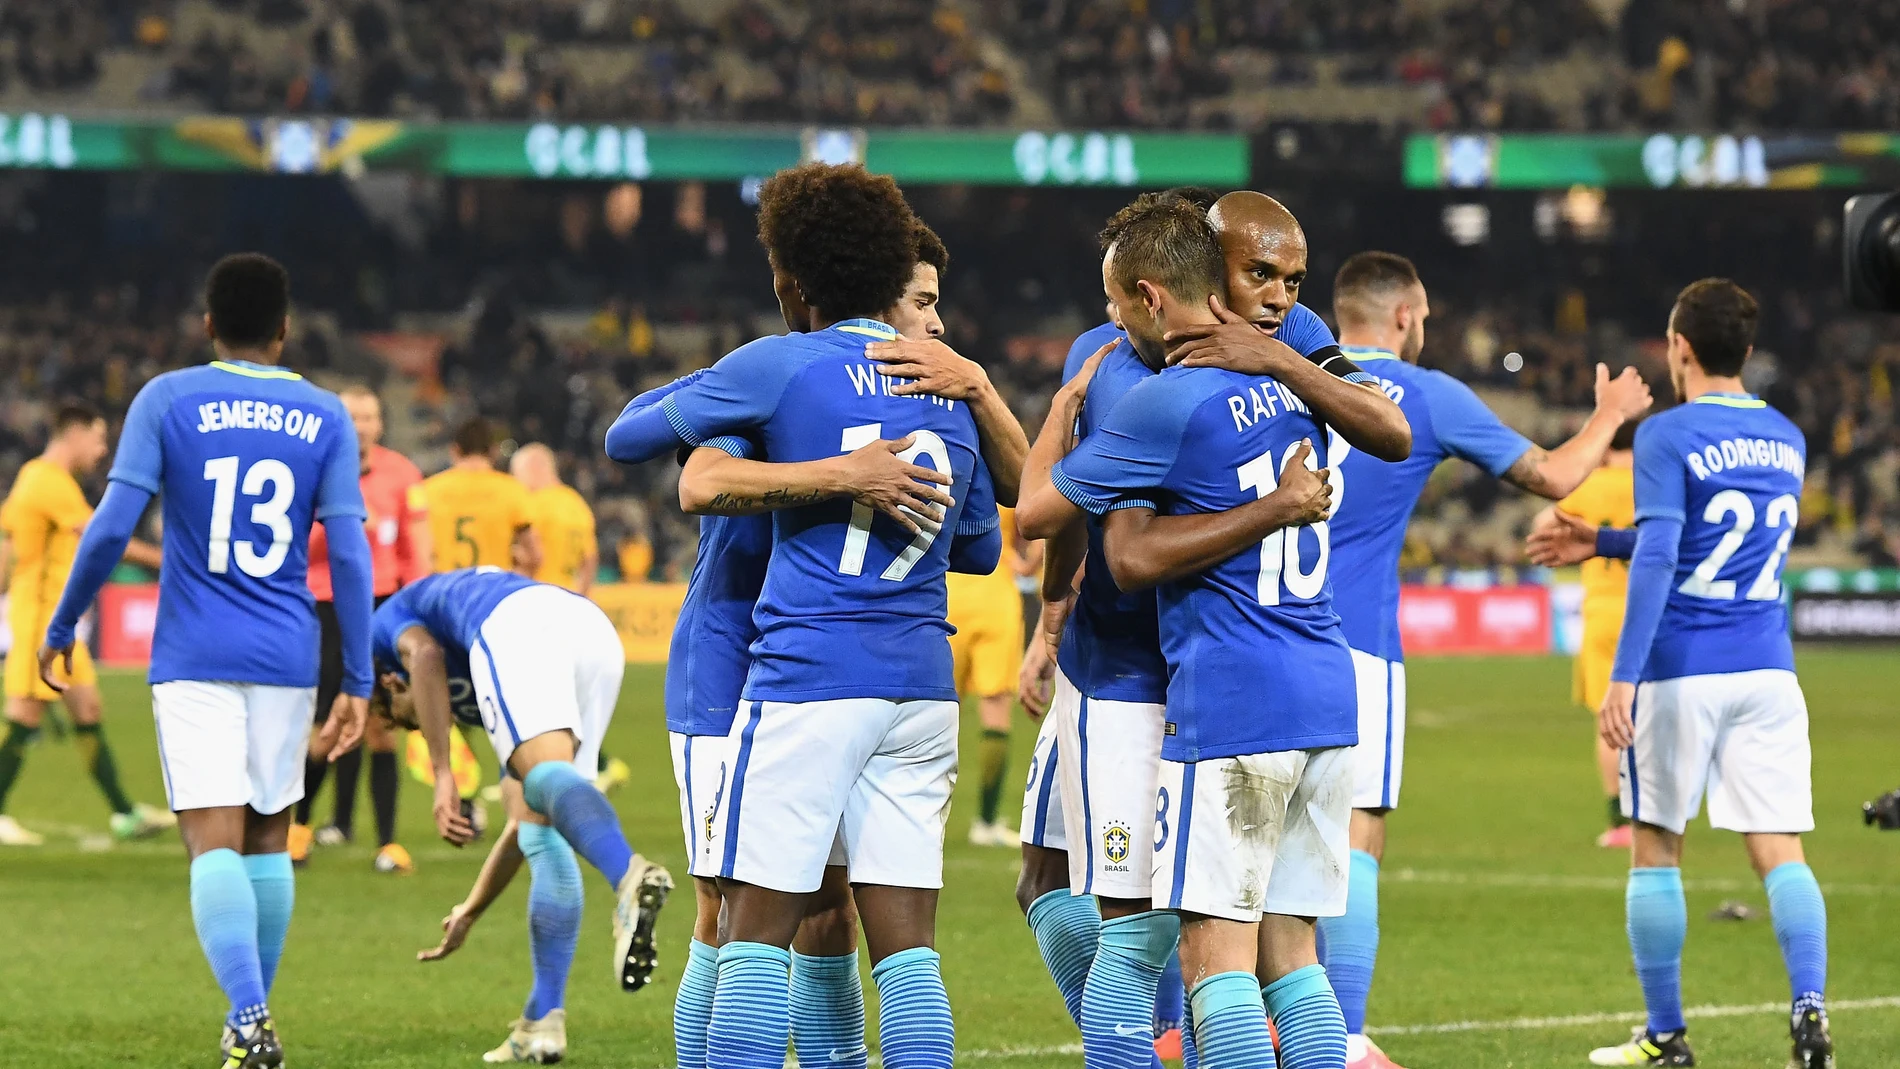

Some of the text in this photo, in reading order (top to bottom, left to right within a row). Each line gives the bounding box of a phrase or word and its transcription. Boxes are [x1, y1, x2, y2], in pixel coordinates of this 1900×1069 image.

[867, 321, 891, 334] BRASIL
[197, 400, 323, 444] JEMERSON
[203, 455, 296, 578] 13
[838, 423, 953, 582] 19
[455, 516, 480, 568] 5
[1677, 488, 1800, 601] 22
[1153, 786, 1170, 853] 8
[1104, 864, 1130, 872] BRASIL
